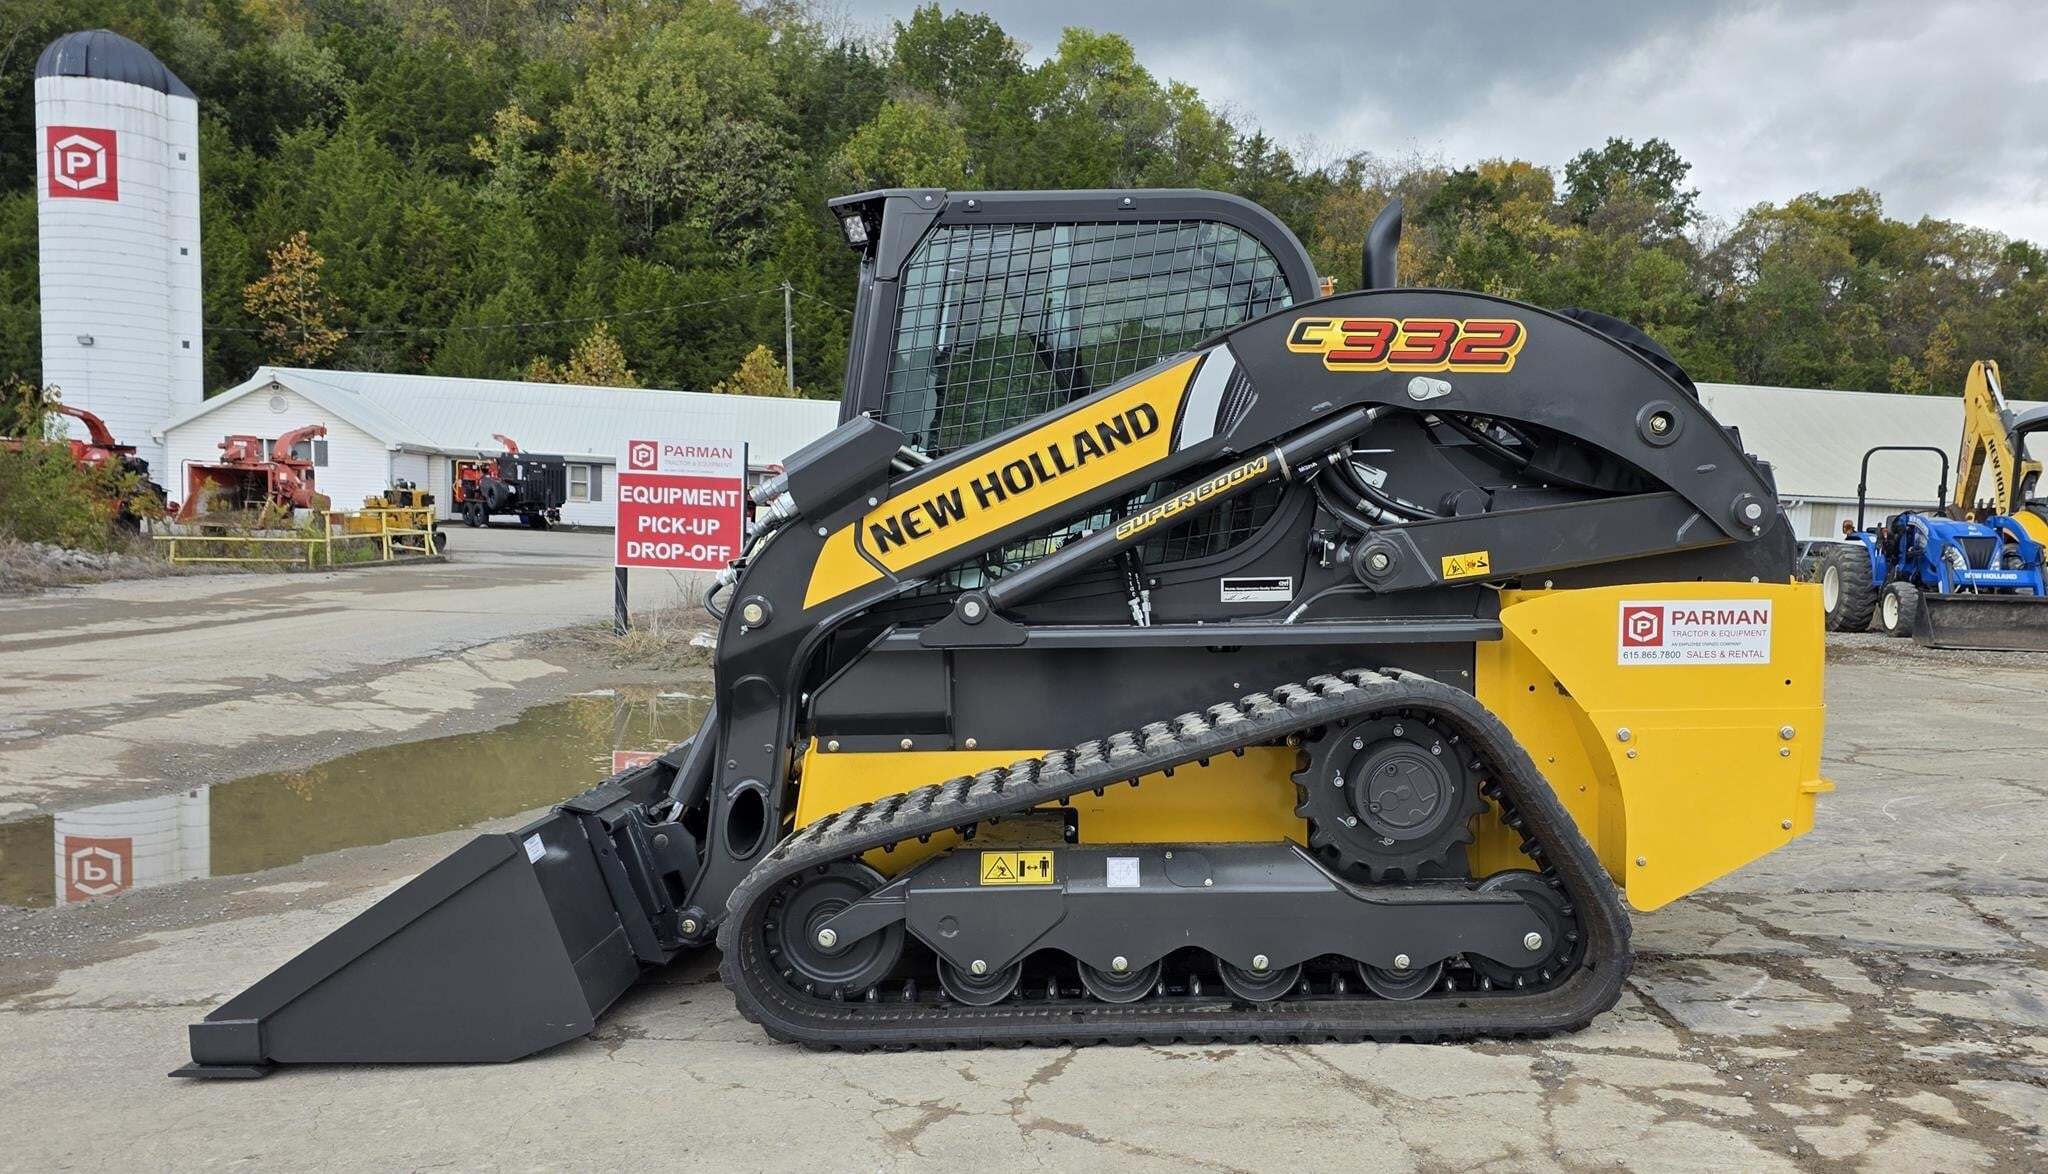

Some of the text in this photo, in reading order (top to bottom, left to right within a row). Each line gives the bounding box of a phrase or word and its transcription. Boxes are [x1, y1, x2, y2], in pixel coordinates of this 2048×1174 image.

[67, 151, 91, 174] P
[1287, 317, 1527, 373] C332
[638, 450, 649, 461] P
[664, 445, 733, 459] PARMAN
[868, 402, 1161, 555] NEW HOLLAND
[1987, 439, 2007, 515] NEW HOLLA
[620, 485, 740, 508] EQUIPMENT
[1116, 455, 1268, 541] SUPER BOOM
[638, 515, 720, 536] PICK-UP
[626, 541, 731, 562] DROP-OFF
[1637, 621, 1651, 634] P
[1671, 609, 1768, 626] PARMAN
[1672, 630, 1709, 638] TRACTOR
[1719, 629, 1767, 638] EQUIPMENT
[1623, 650, 1681, 659] 615.865.7800
[1686, 650, 1717, 659] SALES
[1728, 650, 1765, 658] RENTAL
